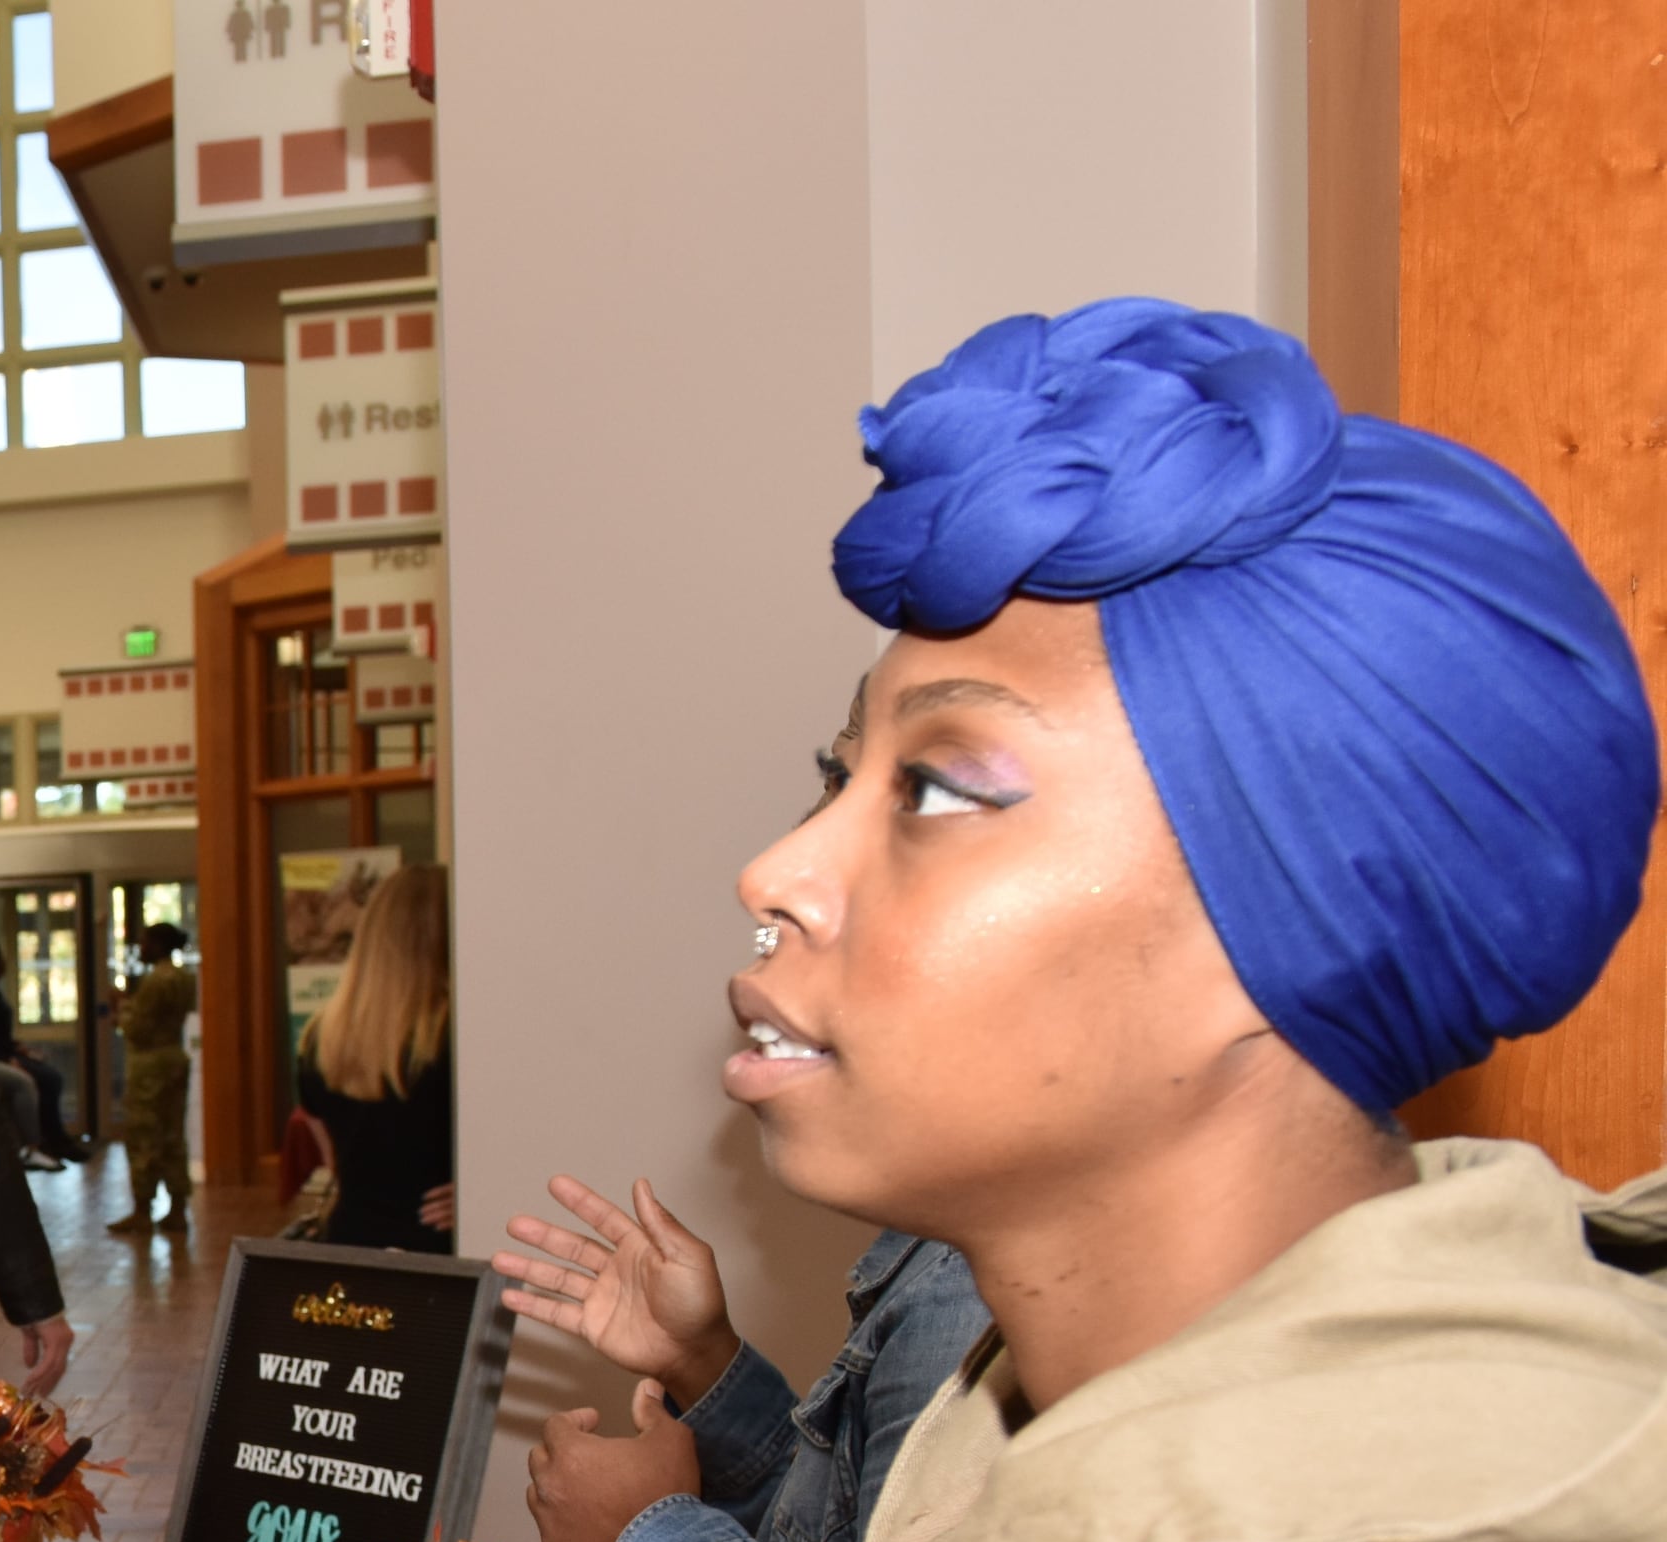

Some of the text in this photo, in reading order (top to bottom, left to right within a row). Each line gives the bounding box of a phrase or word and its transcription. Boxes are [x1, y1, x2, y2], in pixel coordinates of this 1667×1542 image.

[259, 1353, 404, 1400] WHAT ARE
[292, 1404, 357, 1441] YOUR
[234, 1442, 423, 1502] BREASTFEEDING
